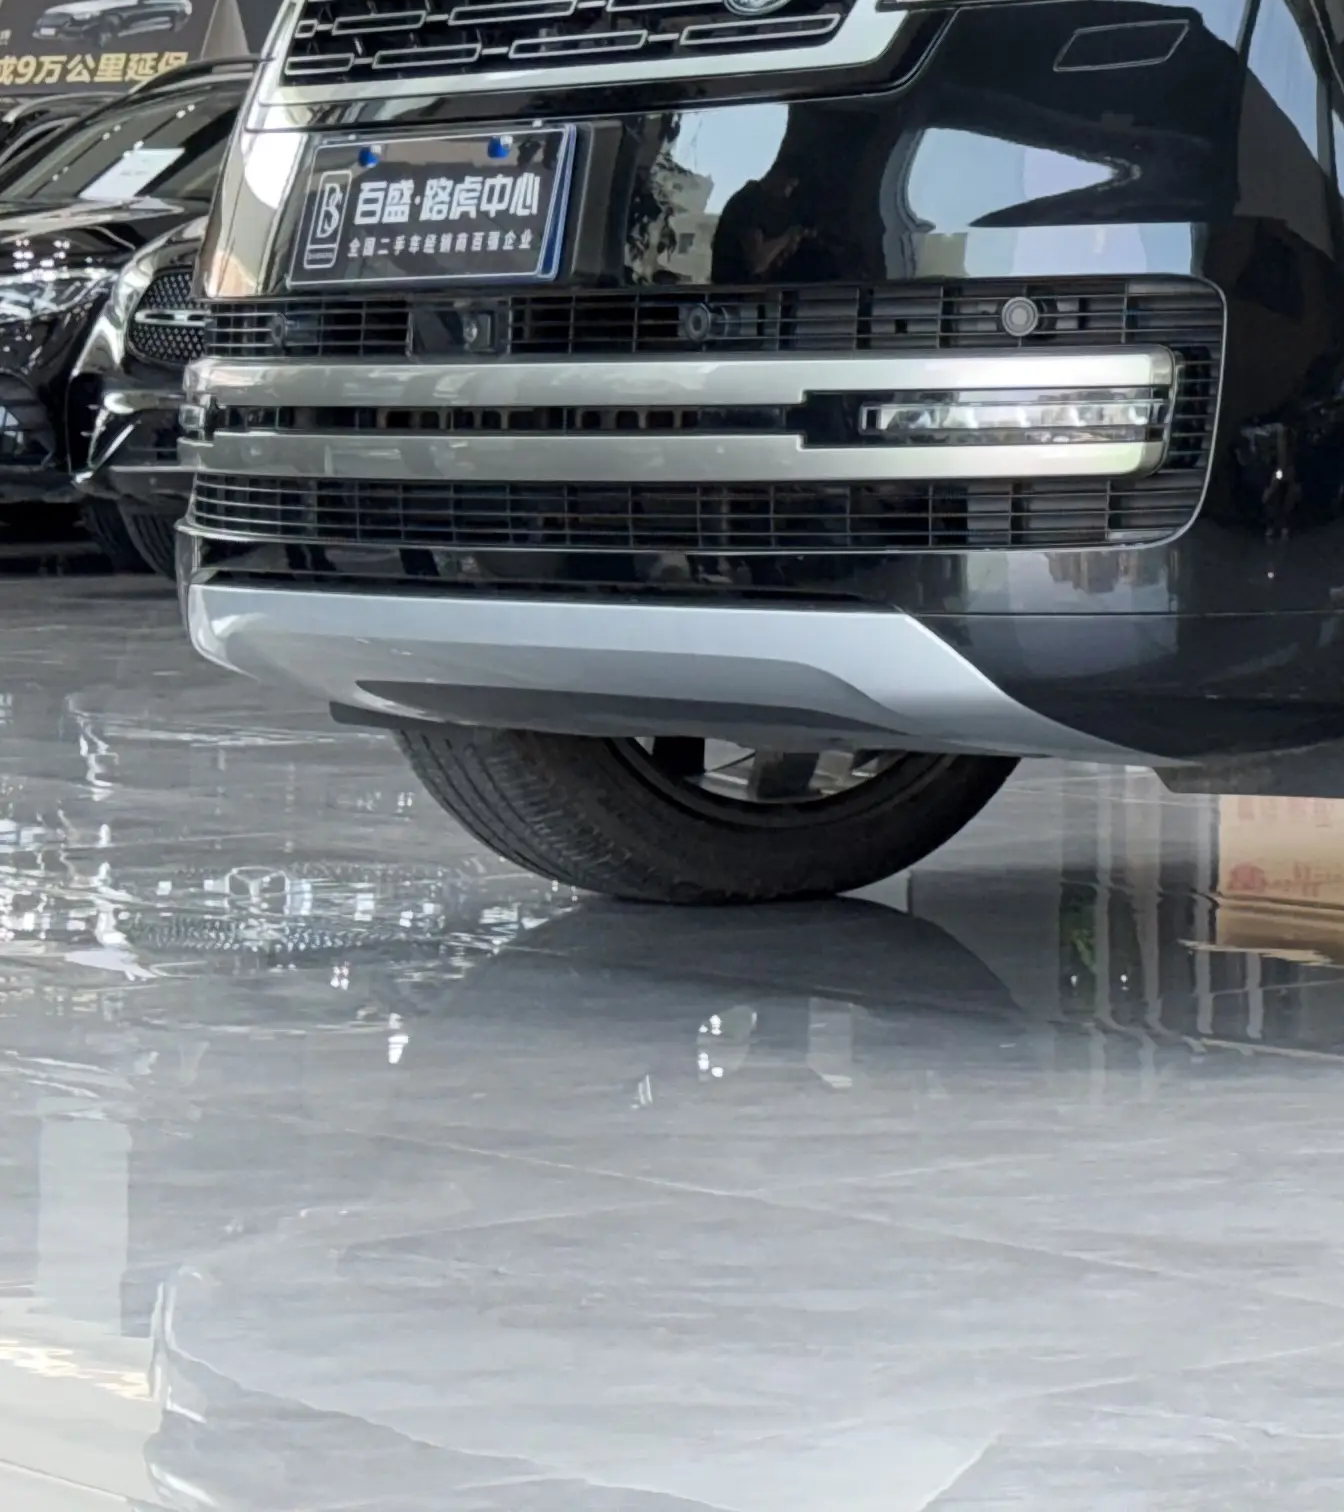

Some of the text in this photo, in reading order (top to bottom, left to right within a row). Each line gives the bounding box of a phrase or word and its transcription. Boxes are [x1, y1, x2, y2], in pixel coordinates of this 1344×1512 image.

[353, 172, 540, 225] 百盛·路虎中心
